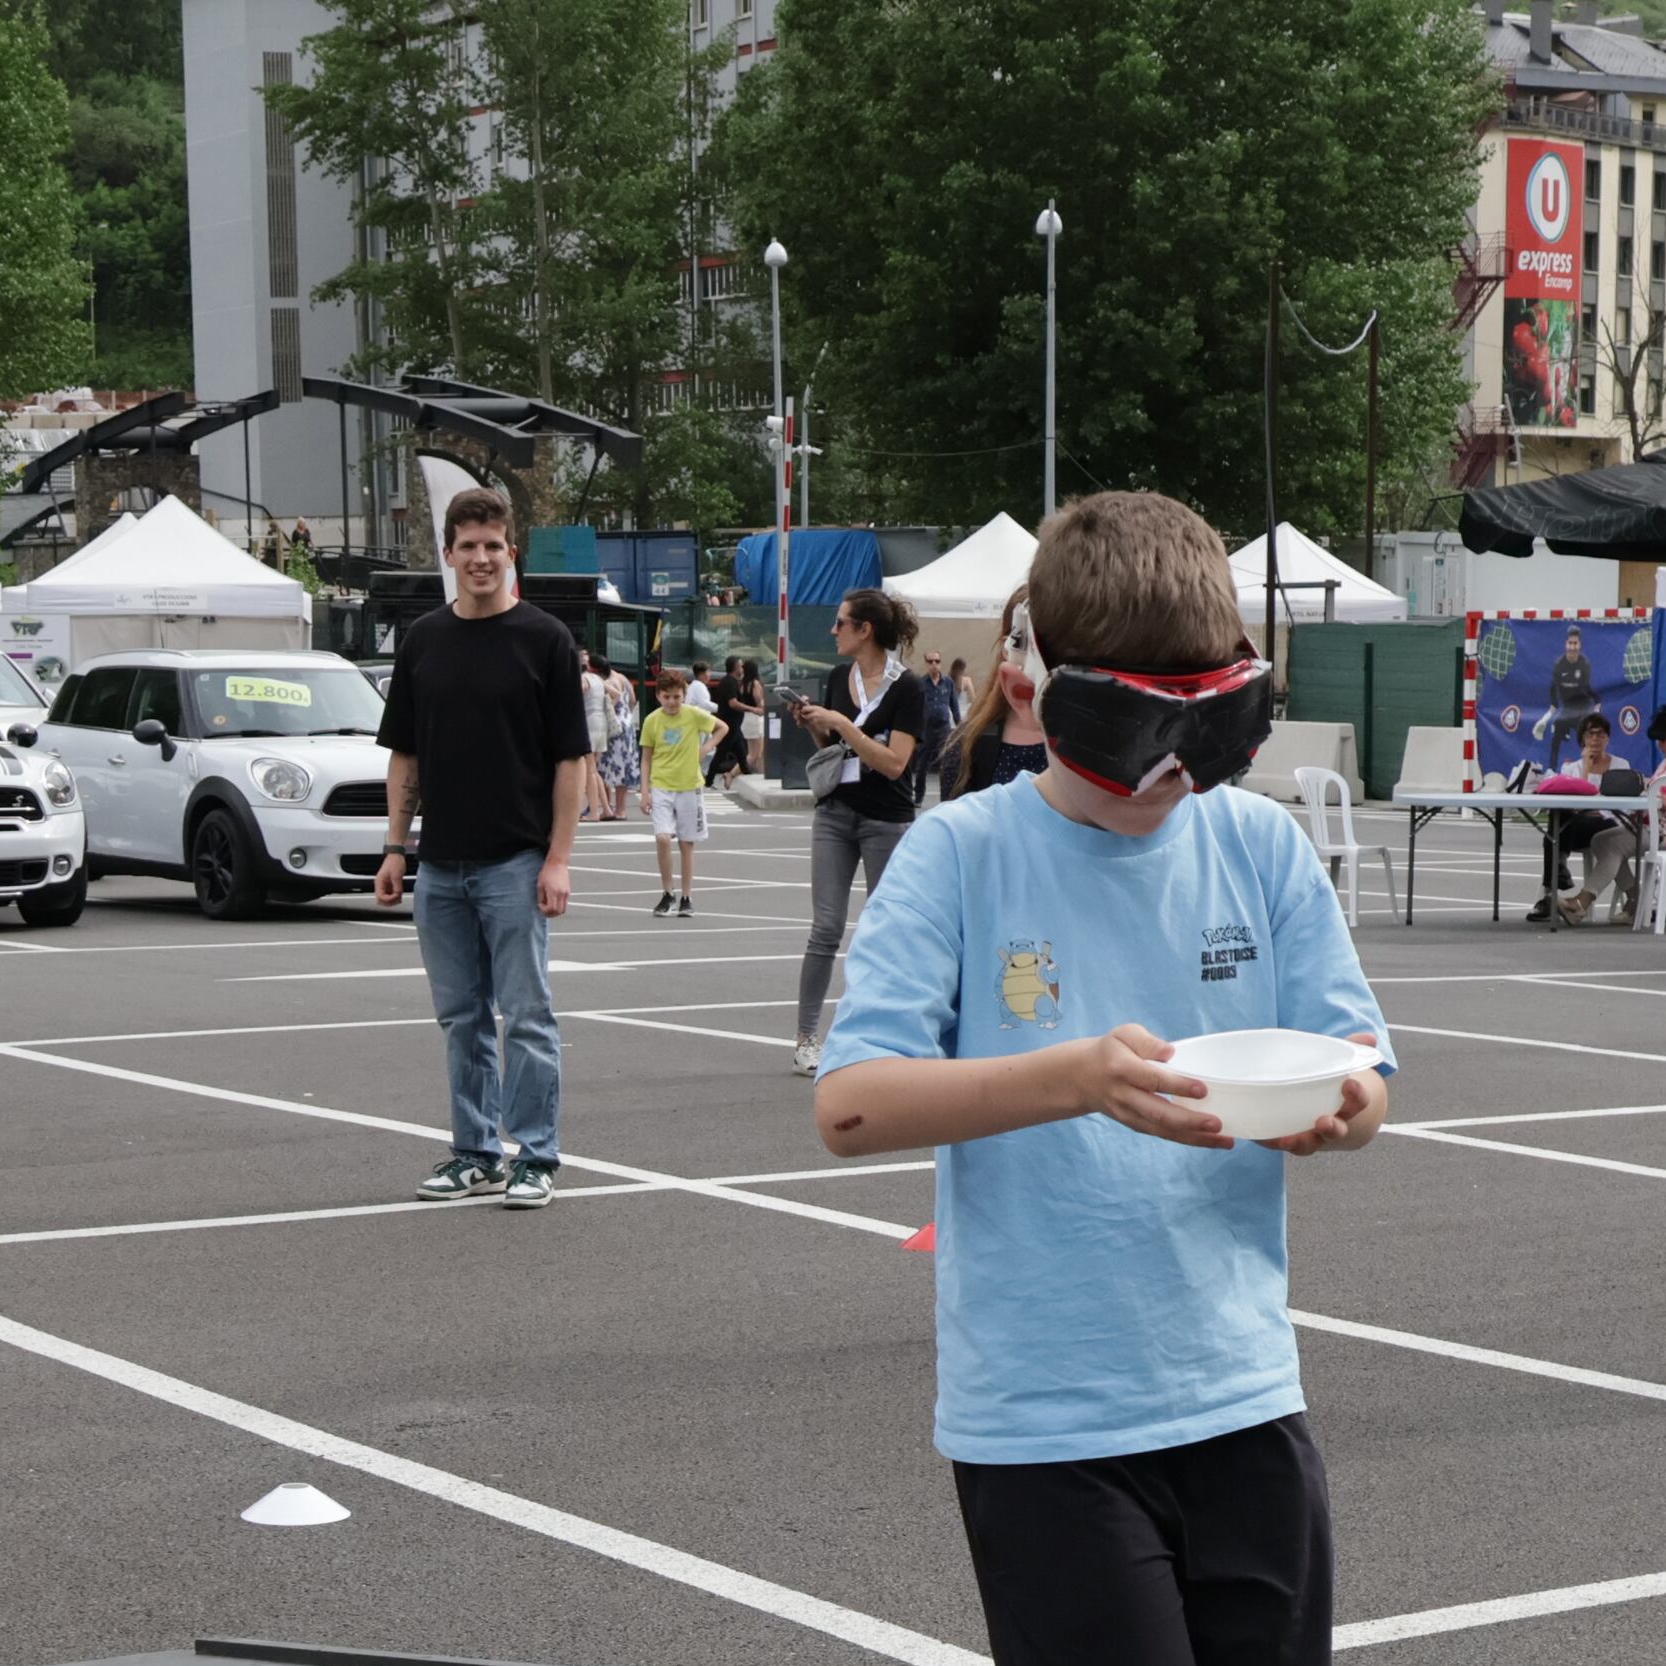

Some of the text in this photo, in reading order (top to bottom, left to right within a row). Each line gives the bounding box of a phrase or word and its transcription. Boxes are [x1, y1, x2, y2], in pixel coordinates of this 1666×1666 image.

[1541, 165, 1560, 215] U
[1518, 250, 1573, 279] express
[1544, 273, 1573, 293] Encamp
[1201, 946, 1259, 966] BLASTOISE
